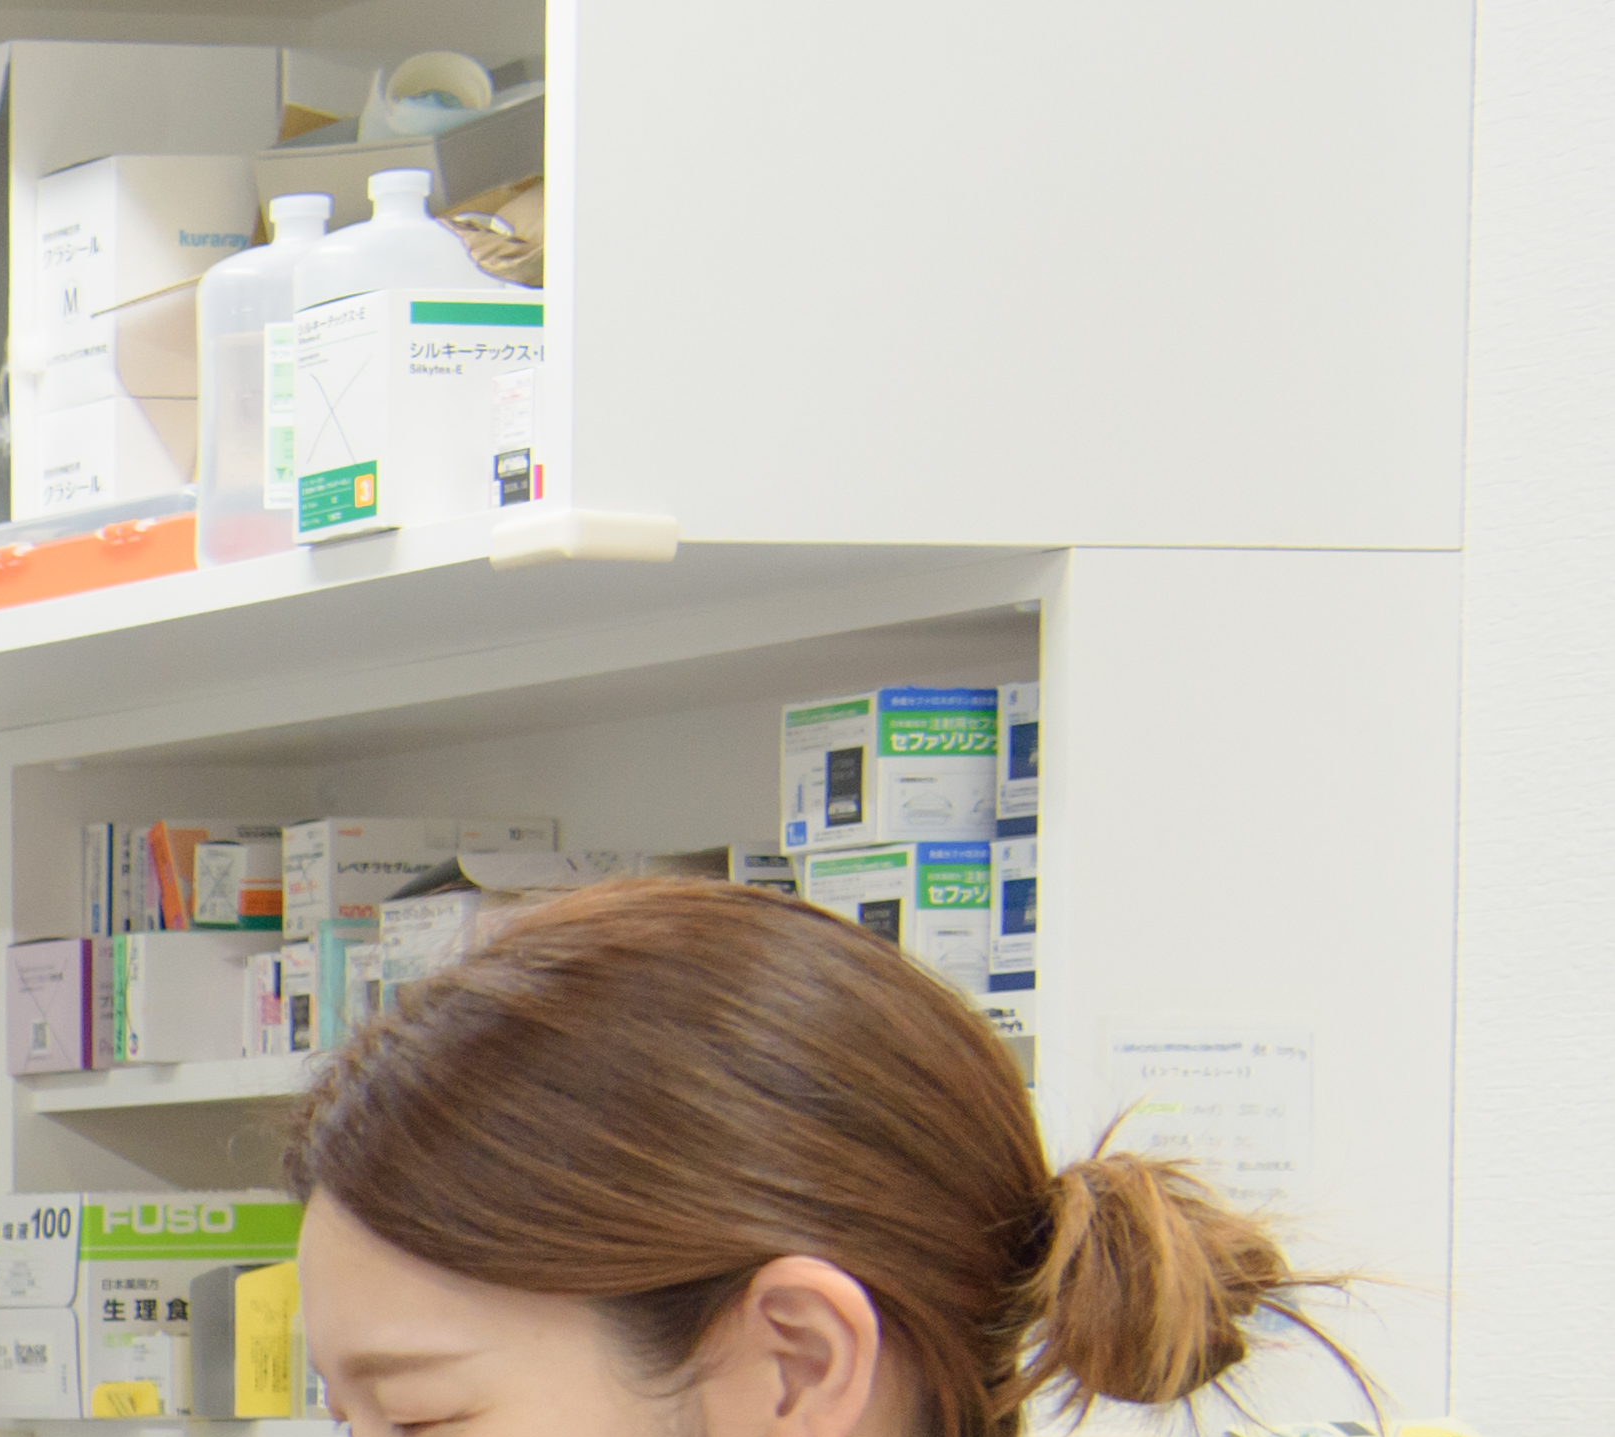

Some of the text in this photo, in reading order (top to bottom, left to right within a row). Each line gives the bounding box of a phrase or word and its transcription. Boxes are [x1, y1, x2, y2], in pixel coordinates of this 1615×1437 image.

[179, 229, 250, 250] kuraray
[409, 363, 463, 376] Silkytex-E
[30, 1207, 72, 1240] 100
[102, 1203, 235, 1235] FUSO
[103, 1298, 190, 1323] 生理食
